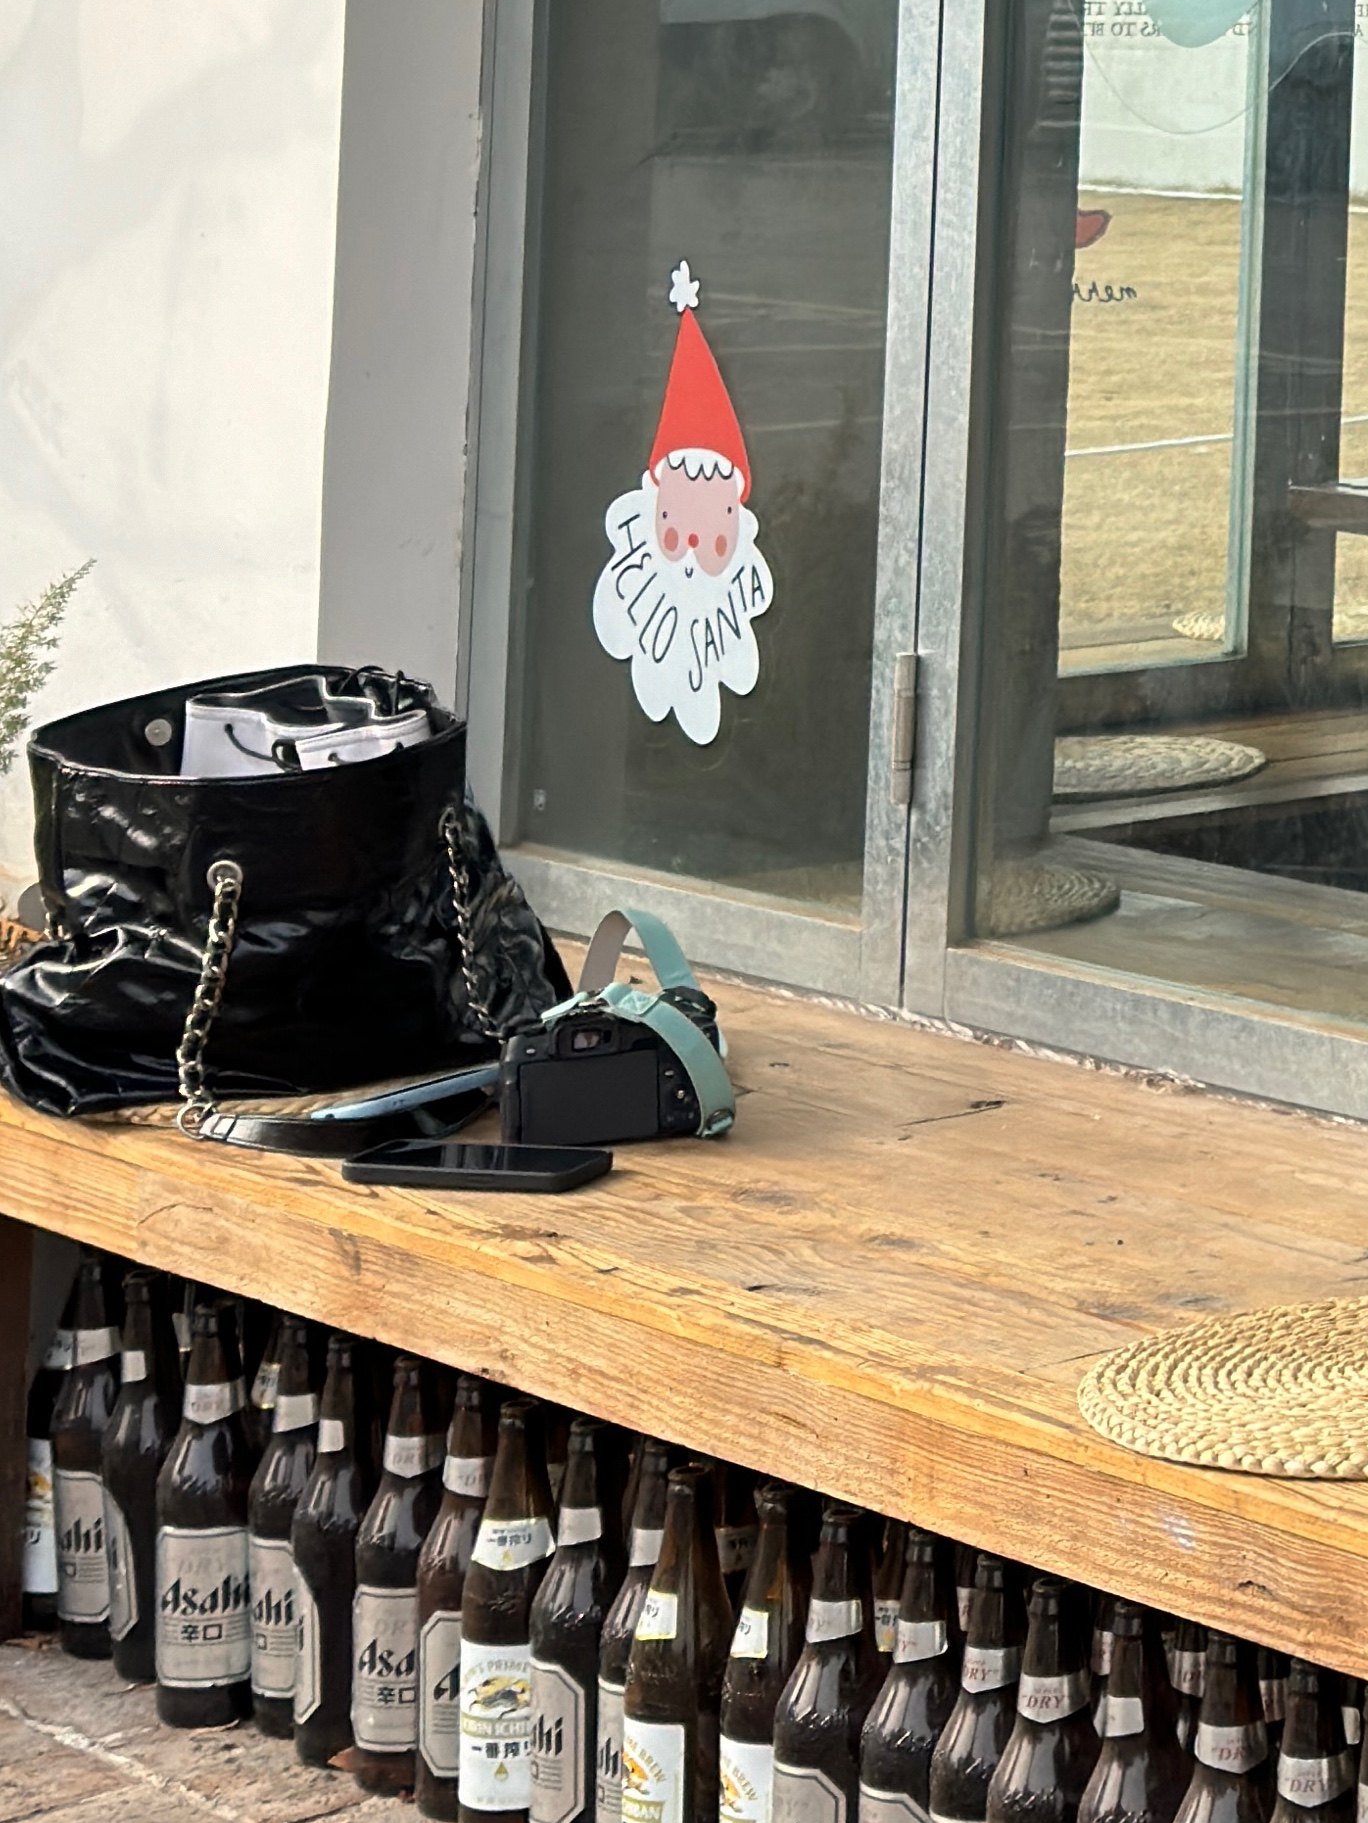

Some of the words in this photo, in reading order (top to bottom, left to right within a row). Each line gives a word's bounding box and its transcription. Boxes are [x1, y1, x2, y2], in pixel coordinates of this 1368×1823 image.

[689, 564, 767, 693] SANTA
[181, 1624, 222, 1643] 辛口
[1026, 1695, 1066, 1709] DRY
